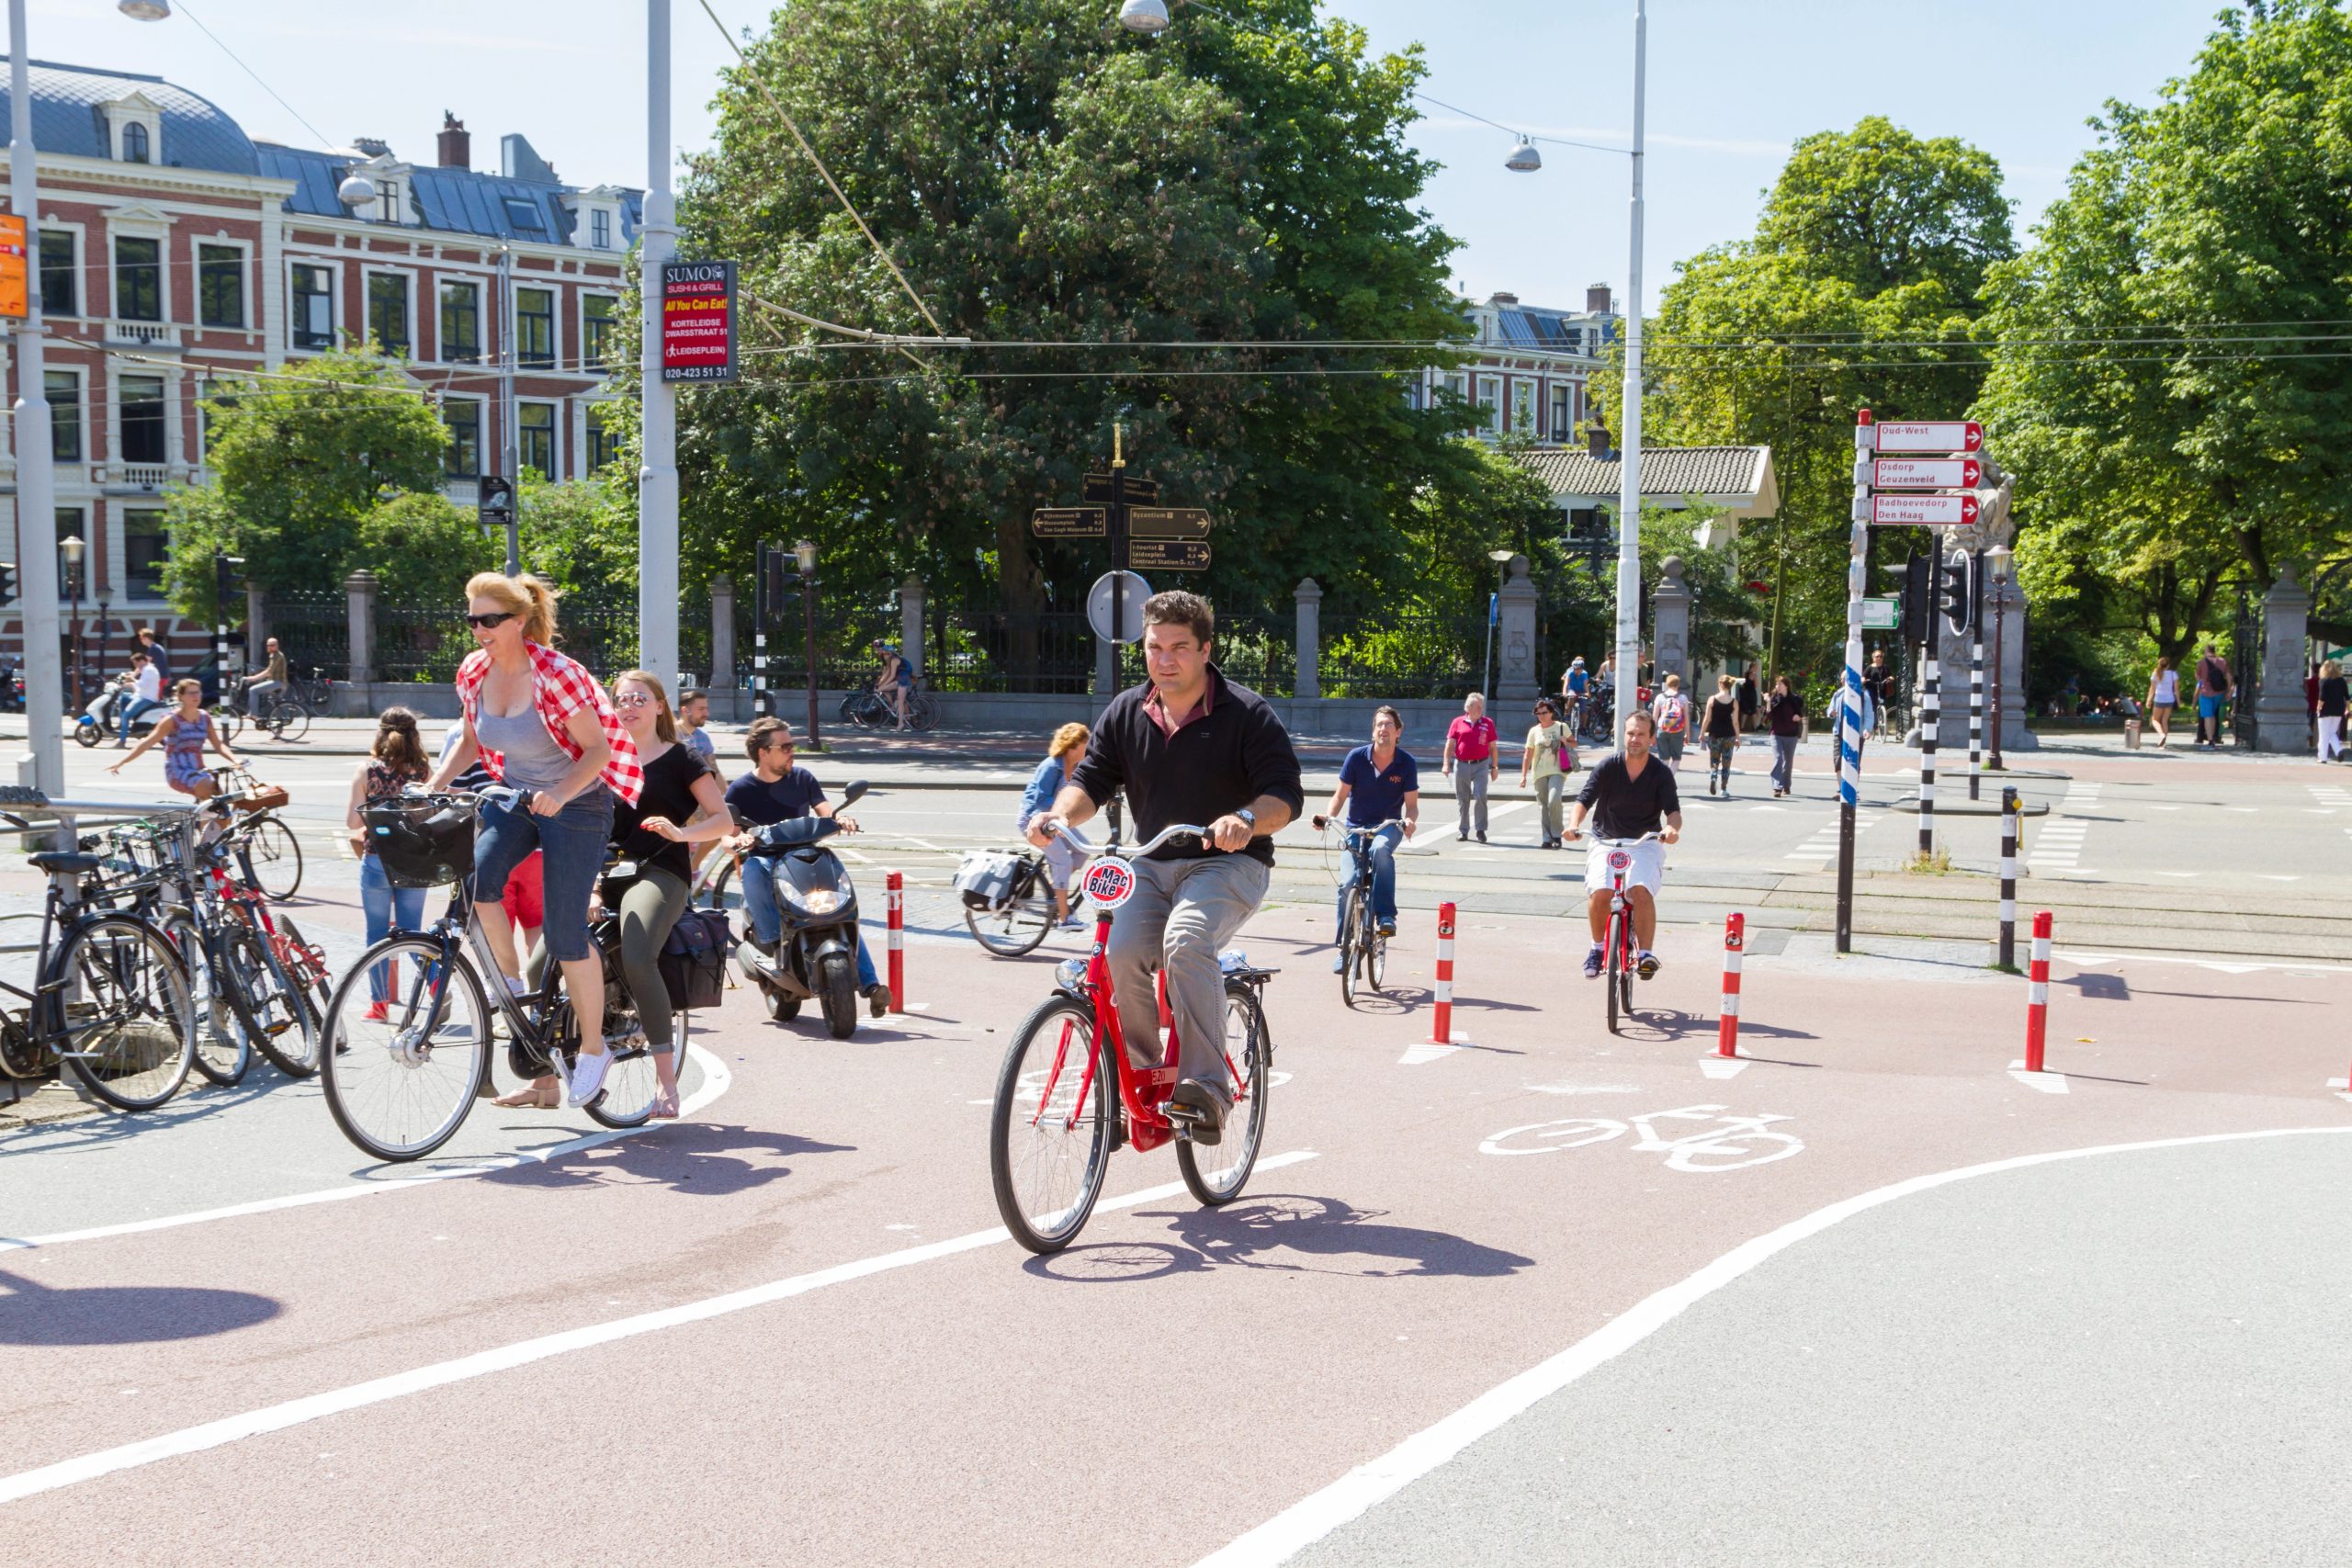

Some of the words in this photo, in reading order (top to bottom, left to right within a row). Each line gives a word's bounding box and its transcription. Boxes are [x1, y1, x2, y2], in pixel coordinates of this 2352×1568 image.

[667, 265, 711, 282] SUMO
[667, 285, 691, 293] SUSHI
[692, 284, 698, 292] &
[699, 283, 723, 291] GRILL
[665, 301, 675, 311] All
[677, 301, 691, 310] You
[693, 299, 708, 310] Can
[710, 299, 728, 309] Eat!
[665, 329, 718, 338] DWARSSTRAAT
[665, 368, 701, 378] 020-423
[703, 367, 713, 378] 51
[717, 367, 728, 377] 31
[1882, 426, 1929, 434] Oud-West
[1880, 463, 1915, 473] Osdorp
[1879, 475, 1936, 483] Geuzenveld
[1878, 499, 1948, 508] Badhoevedorp
[1878, 511, 1897, 519] Den
[1900, 511, 1924, 521] Haag
[1096, 859, 1130, 873] AMSTERDAM
[1102, 868, 1128, 887] Mac
[1089, 877, 1116, 897] Bike
